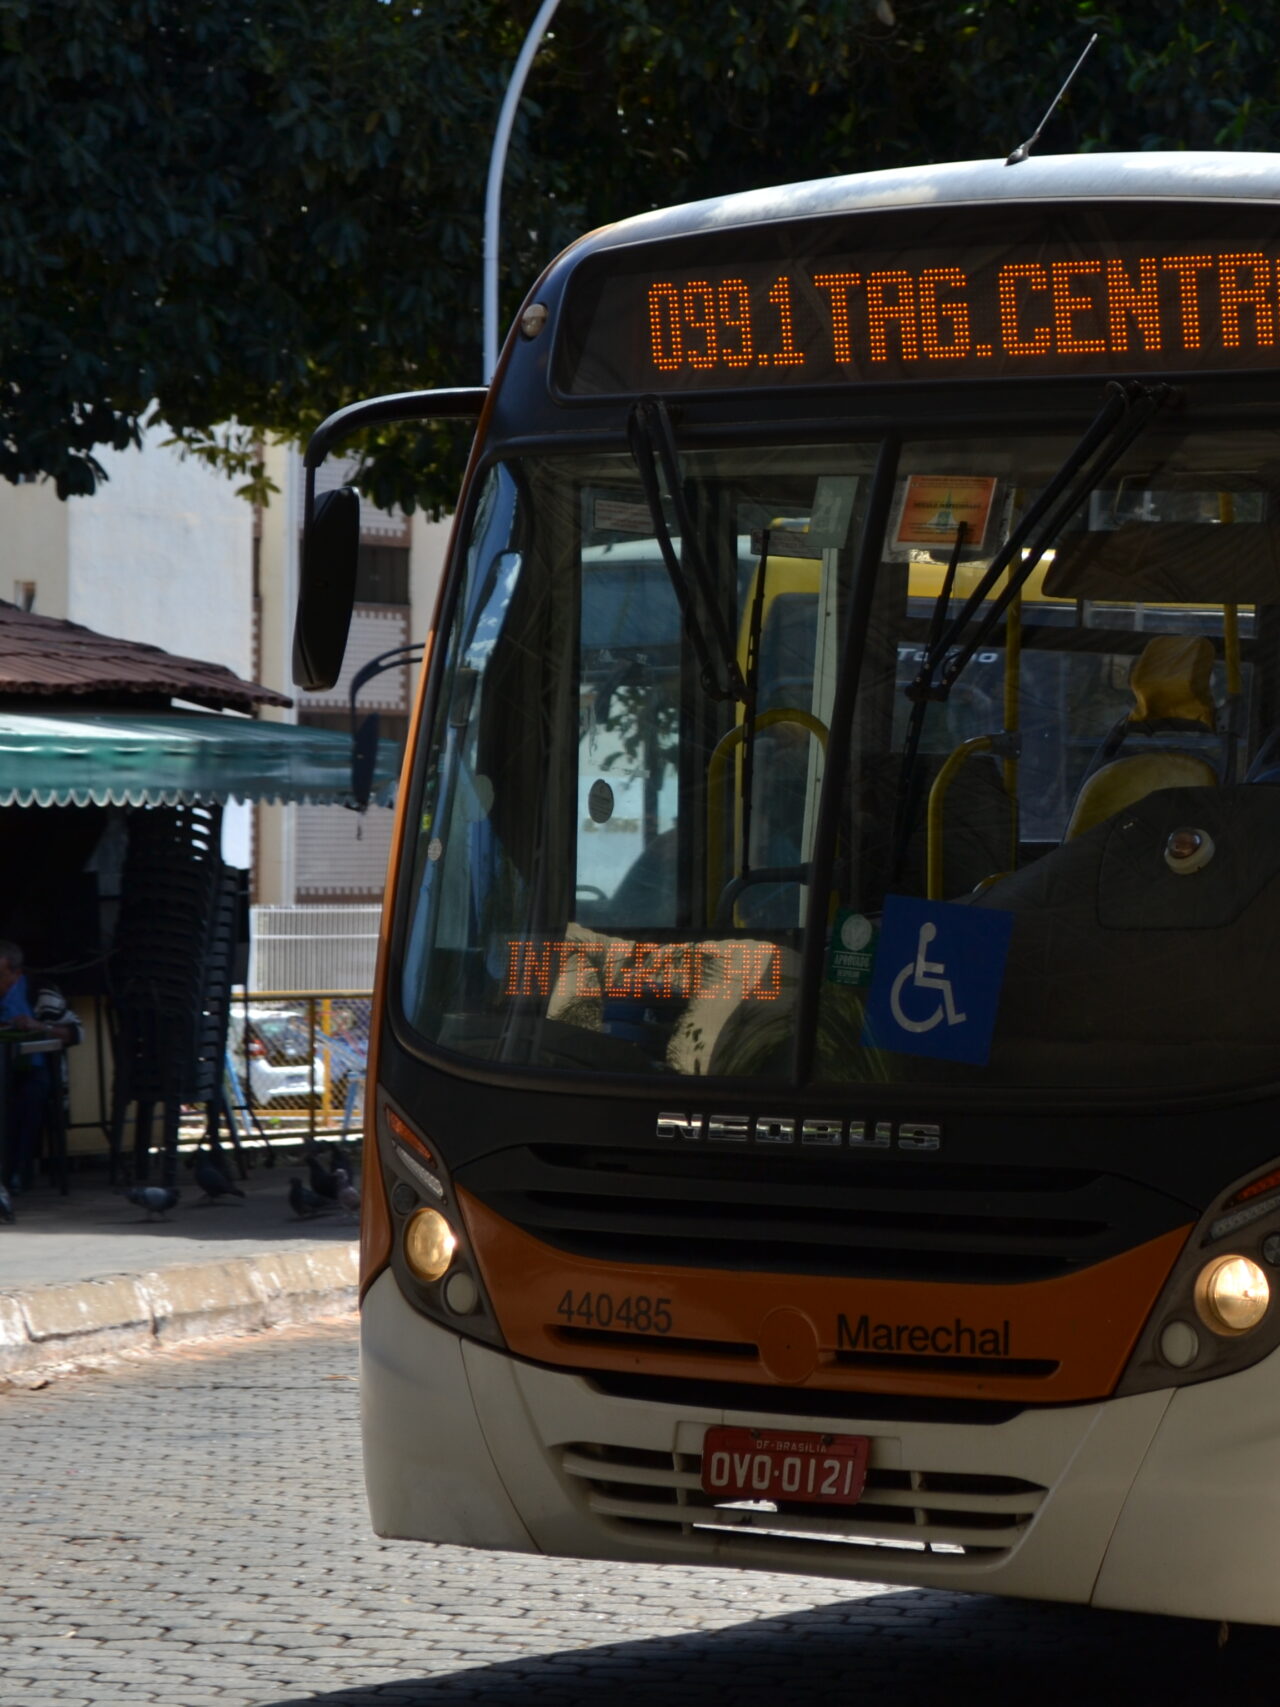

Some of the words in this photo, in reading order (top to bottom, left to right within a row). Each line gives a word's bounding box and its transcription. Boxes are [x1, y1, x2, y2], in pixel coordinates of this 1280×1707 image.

[647, 275, 805, 371] 099.1
[896, 647, 999, 663] Too
[504, 940, 784, 1000] INTEGRACAO
[655, 1111, 944, 1151] NEOBUS
[555, 1289, 674, 1334] 440485
[836, 1312, 1011, 1357] Marechal
